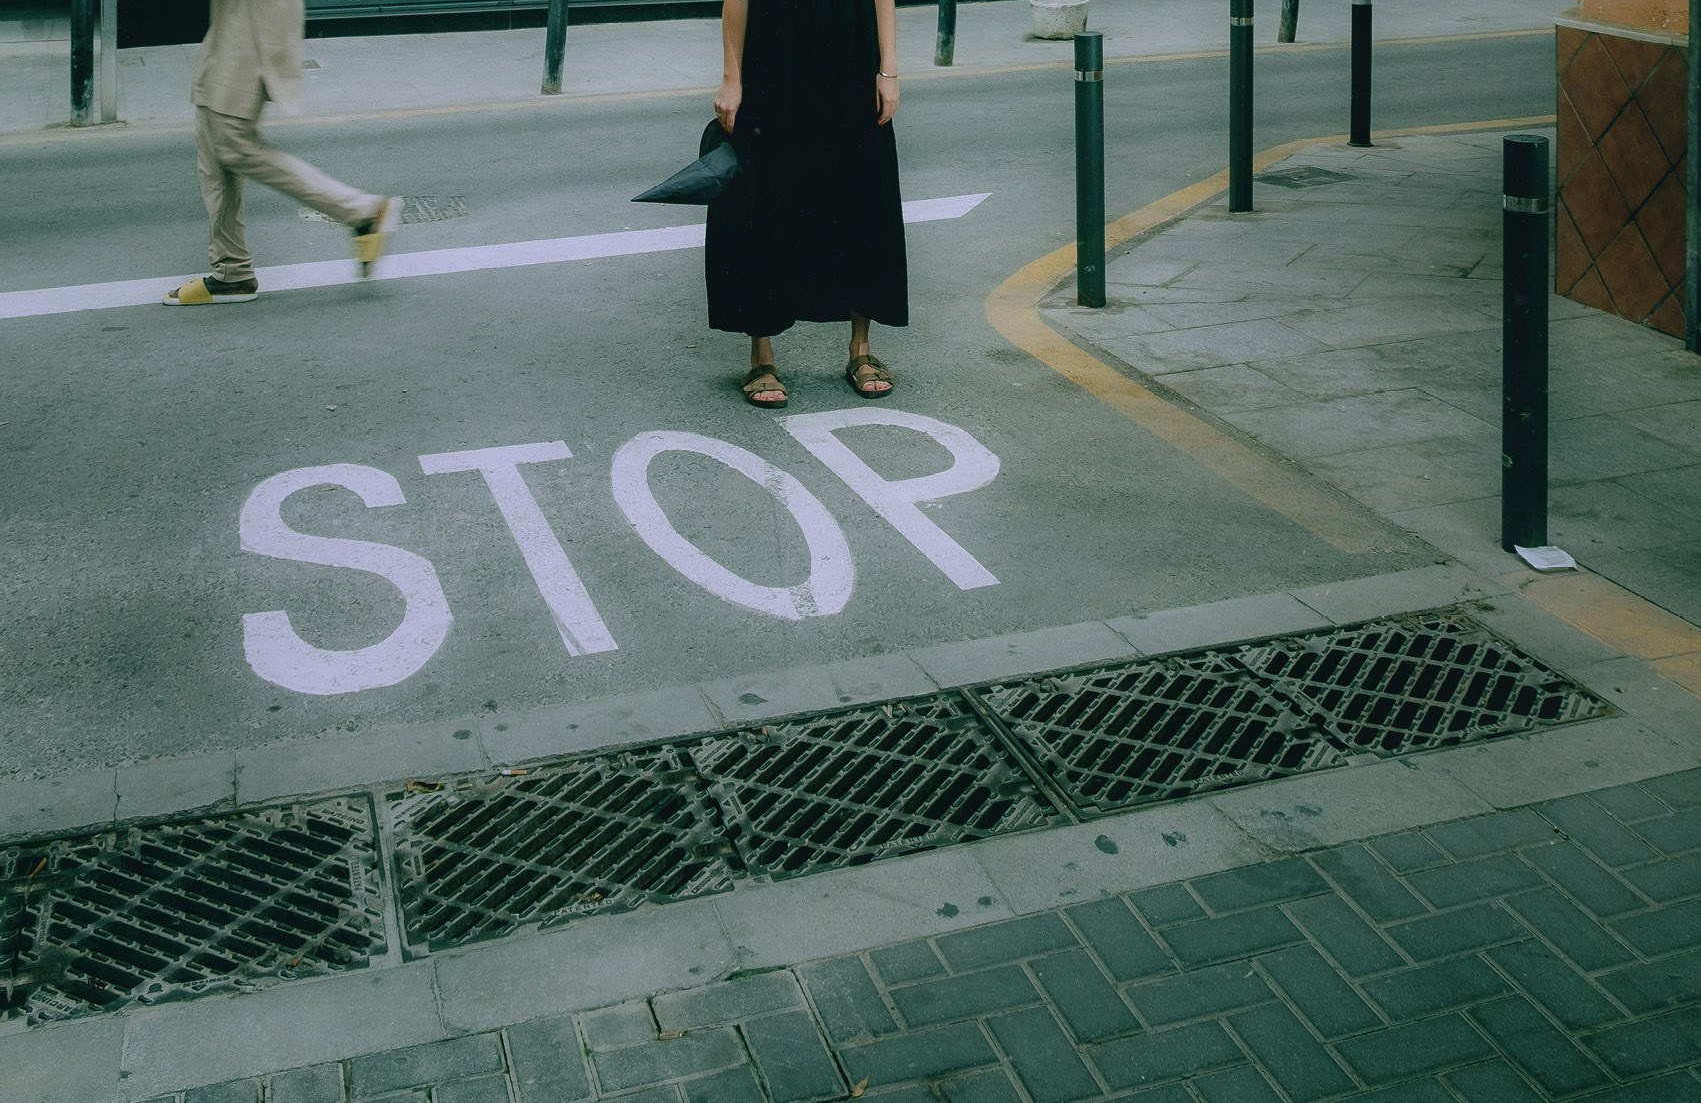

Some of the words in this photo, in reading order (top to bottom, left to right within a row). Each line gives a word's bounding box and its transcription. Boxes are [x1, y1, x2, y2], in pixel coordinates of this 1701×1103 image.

[238, 406, 1001, 695] STOP
[321, 808, 365, 825] BARCINO
[351, 860, 362, 891] PATENTED
[32, 992, 75, 1015] ARCINO
